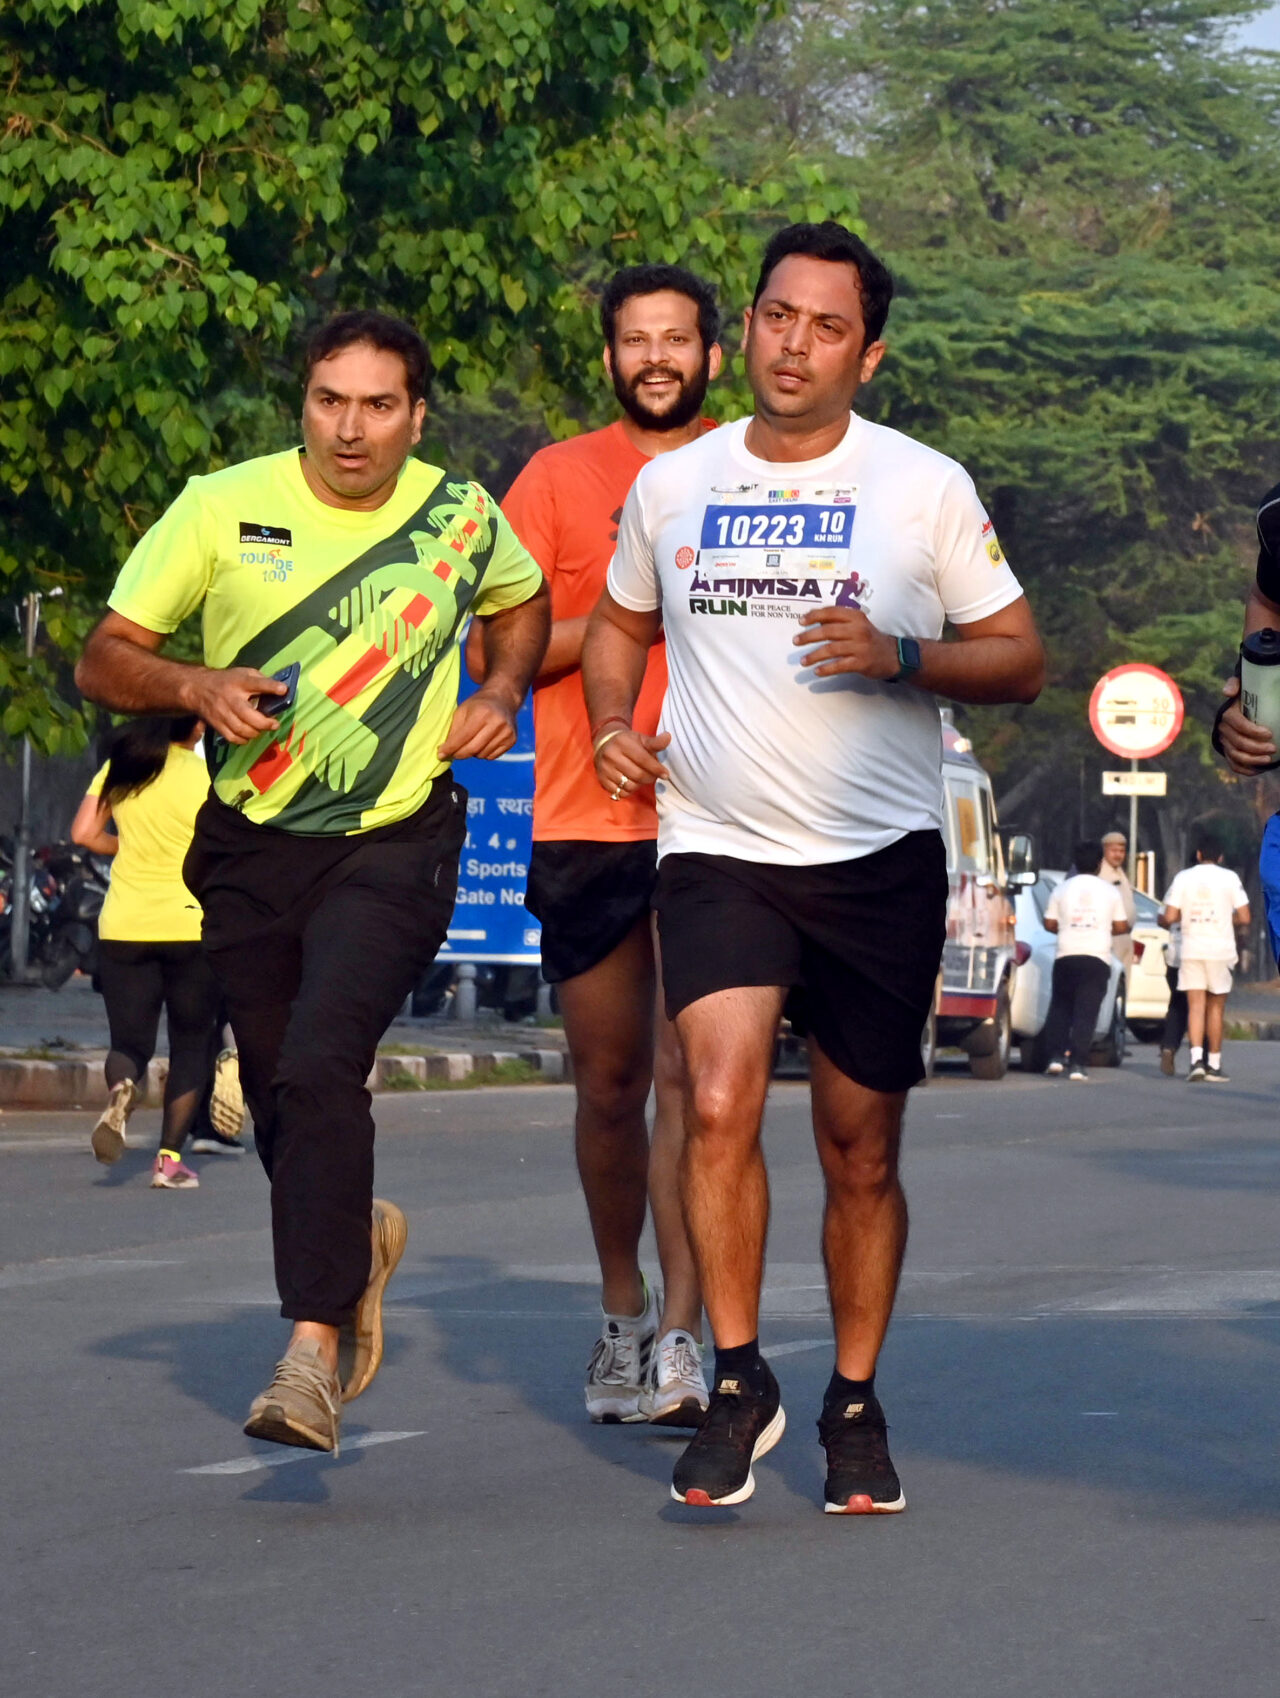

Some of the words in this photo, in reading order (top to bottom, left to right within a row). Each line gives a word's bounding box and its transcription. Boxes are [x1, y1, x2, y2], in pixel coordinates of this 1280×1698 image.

[819, 511, 846, 533] 10
[716, 514, 806, 546] 10223
[241, 535, 290, 545] BERGAMONT
[814, 533, 826, 542] KM
[827, 534, 843, 543] RUN
[240, 552, 275, 564] TOUR
[276, 559, 293, 571] DE
[264, 570, 287, 582] 100
[689, 598, 747, 616] RUN
[751, 603, 766, 611] FOR
[767, 604, 791, 612] PEACE
[1152, 697, 1169, 710] 50
[467, 859, 528, 880] Sports
[455, 888, 495, 905] Gate
